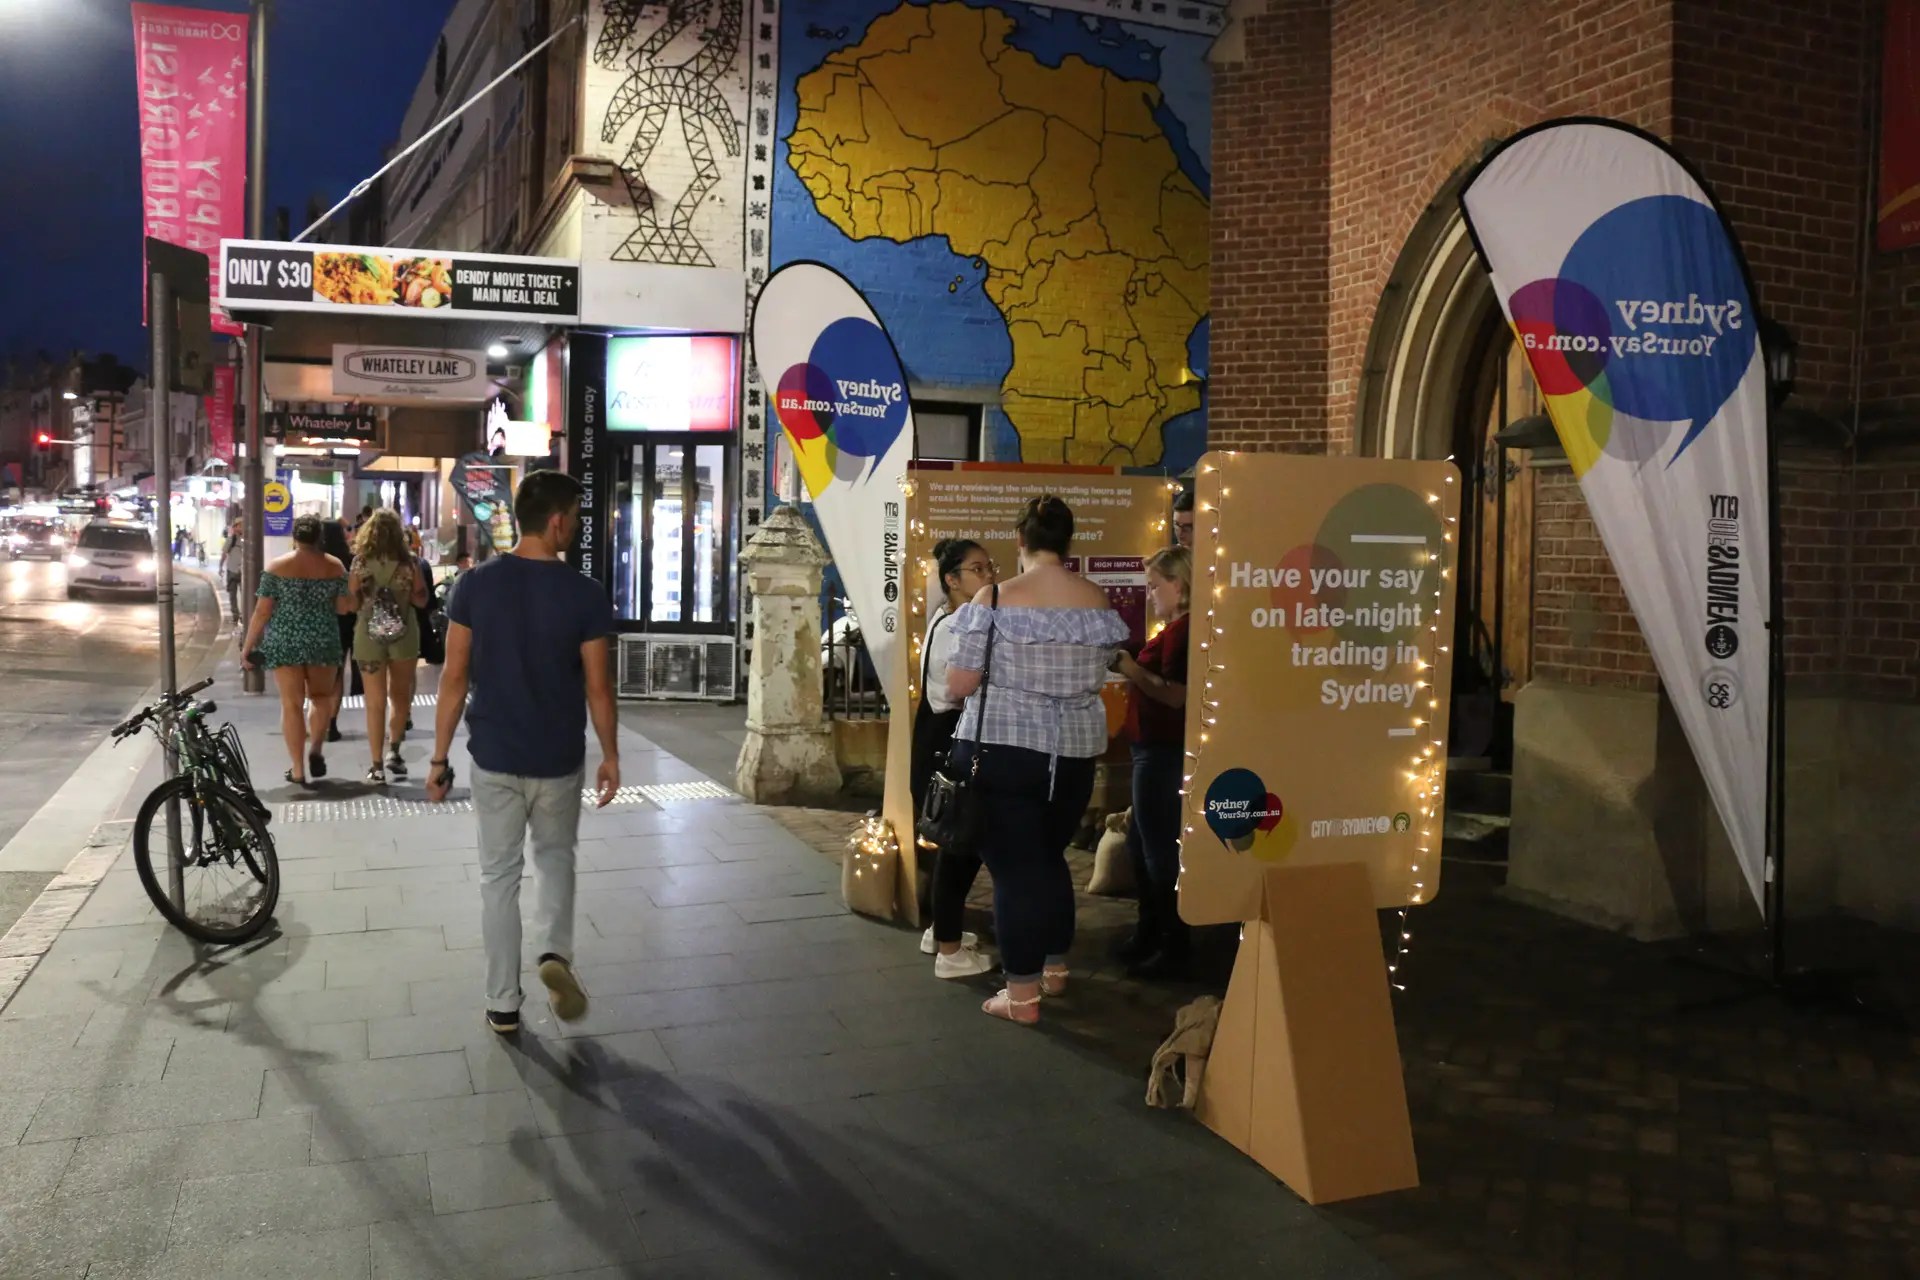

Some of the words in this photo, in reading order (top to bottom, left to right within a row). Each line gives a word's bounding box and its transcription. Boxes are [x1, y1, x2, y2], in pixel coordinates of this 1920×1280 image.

[228, 258, 272, 286] ONLY
[278, 259, 312, 289] $30
[456, 269, 490, 285] DENDY
[493, 271, 525, 287] MOVIE
[527, 273, 563, 289] TICKET
[472, 287, 500, 303] MAIN
[502, 289, 531, 304] MEAL
[533, 291, 559, 306] DEAL
[362, 357, 425, 374] WHATELEY
[428, 361, 459, 376] LANE
[584, 386, 597, 423] away
[289, 415, 352, 432] Whateley
[356, 418, 371, 431] La
[581, 427, 594, 459] Take
[581, 472, 593, 484] In
[929, 482, 943, 491] We
[961, 483, 1004, 494] reviewing
[1006, 484, 1020, 492] the
[1021, 484, 1044, 493] rules
[1045, 485, 1057, 493] for
[1059, 486, 1089, 496] trading
[1091, 487, 1115, 495] hours
[1117, 488, 1132, 496] and
[970, 494, 1021, 503] businesses
[580, 516, 593, 549] Food
[929, 528, 956, 539] How
[959, 529, 981, 539] late
[1230, 562, 1301, 588] Have
[1309, 568, 1371, 595] your
[1379, 568, 1425, 595] say
[1251, 607, 1286, 628] on
[1295, 602, 1422, 633] late-night
[1291, 640, 1388, 671] trading
[1396, 640, 1420, 664] in
[1320, 678, 1417, 711] Sydney
[1209, 799, 1250, 812] Sydney
[1218, 810, 1280, 820] YourSay.com.au
[1311, 819, 1331, 838] CITY
[1342, 817, 1377, 836] SYDNEY
